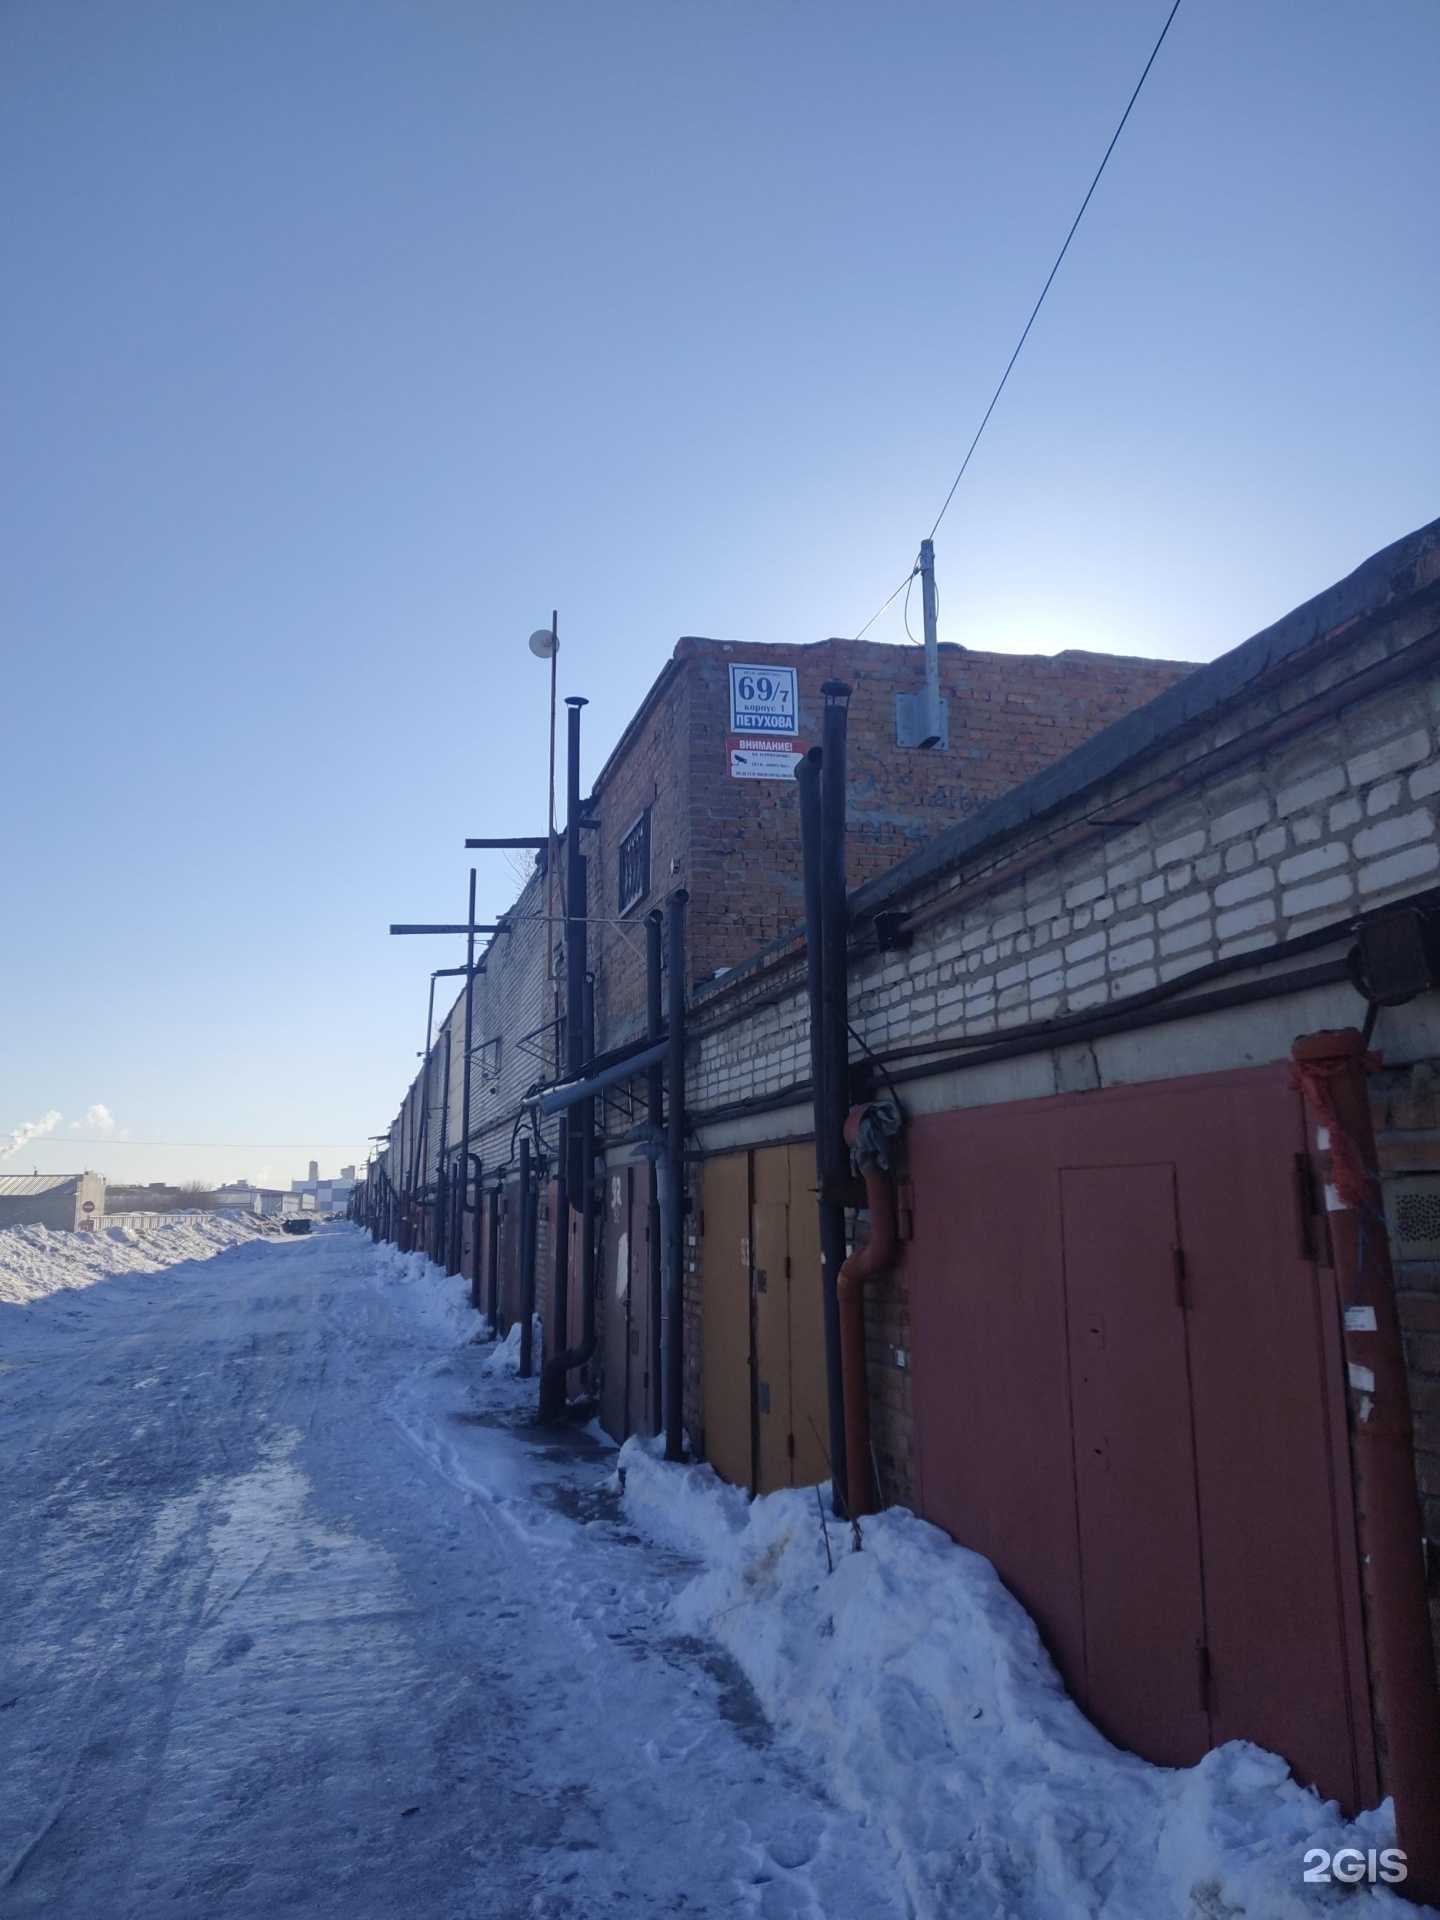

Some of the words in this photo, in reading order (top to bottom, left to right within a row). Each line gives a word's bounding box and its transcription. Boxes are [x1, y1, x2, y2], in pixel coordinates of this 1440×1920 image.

[738, 676, 790, 703] 69/7
[744, 703, 777, 713] корпус
[736, 714, 793, 729] ПЕТУХОВА
[739, 739, 793, 752] ВНИМАНИЕ!
